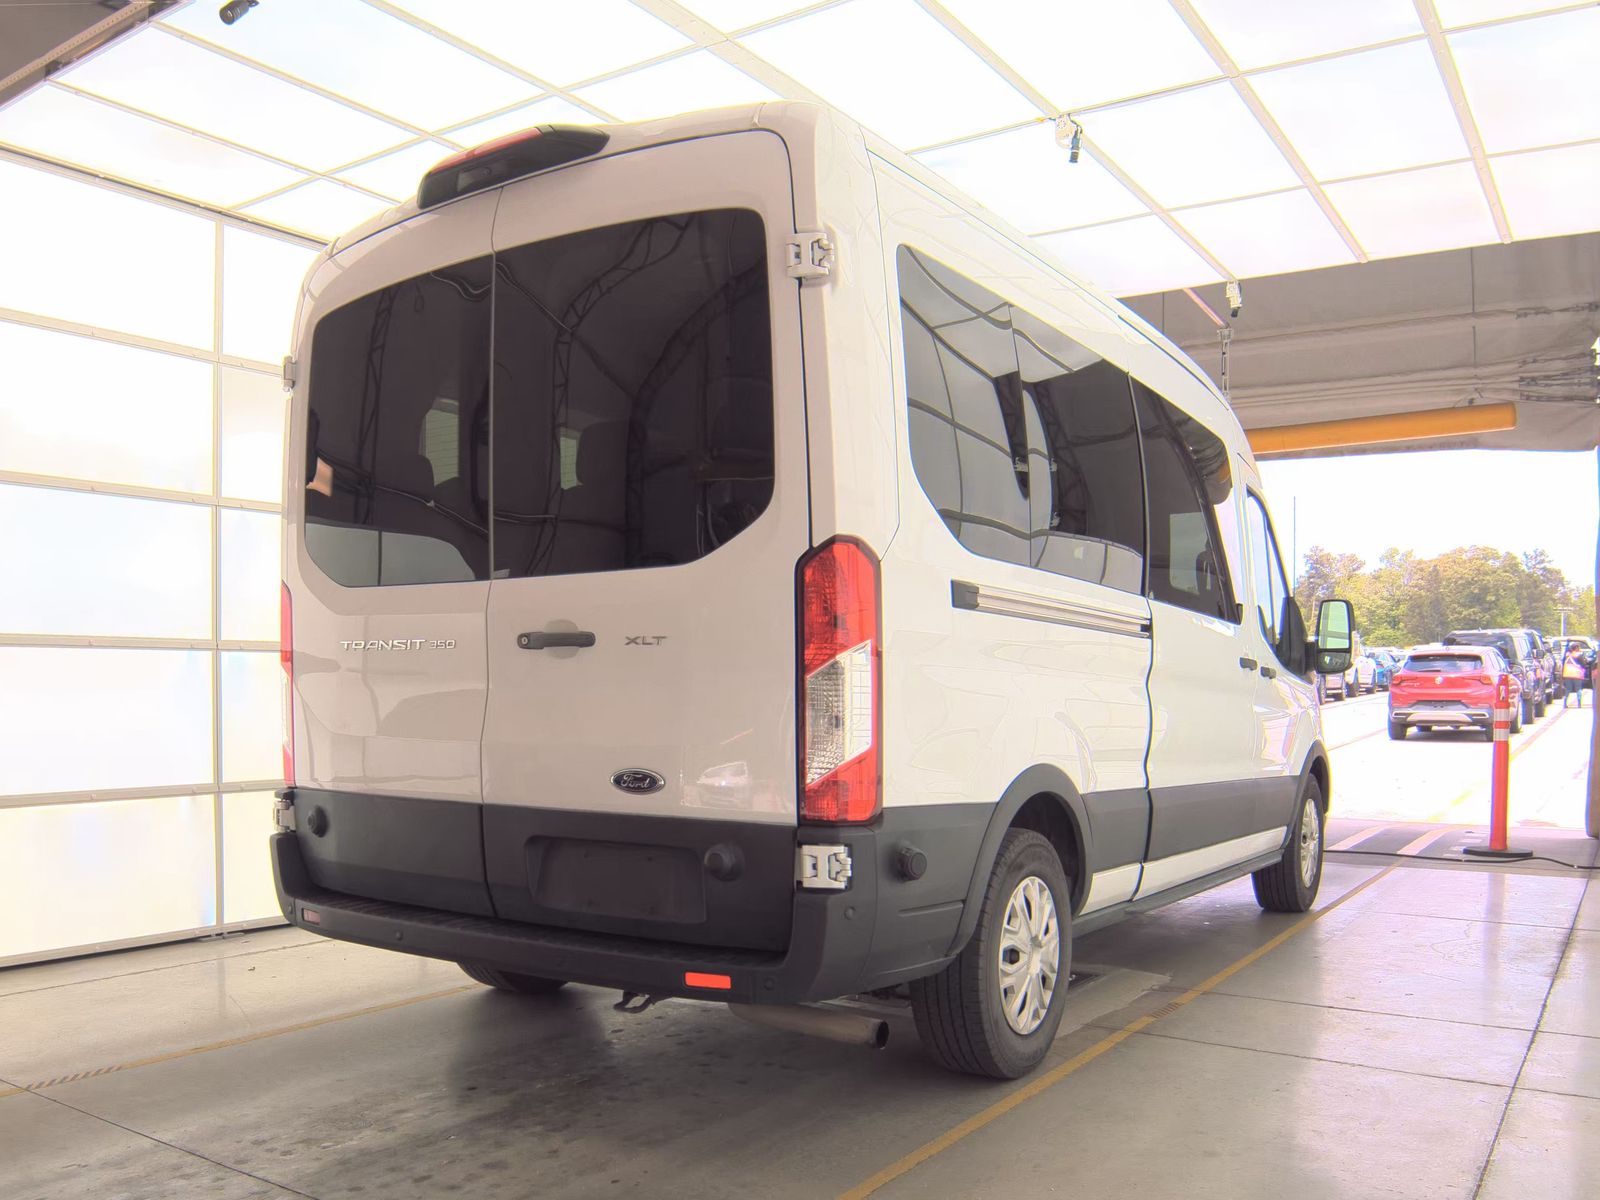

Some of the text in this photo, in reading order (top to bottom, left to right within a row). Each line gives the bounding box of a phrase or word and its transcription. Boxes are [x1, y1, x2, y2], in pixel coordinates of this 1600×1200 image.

[340, 639, 456, 650] TRANSIT 350
[624, 635, 667, 646] XLT
[620, 773, 651, 788] Ford
